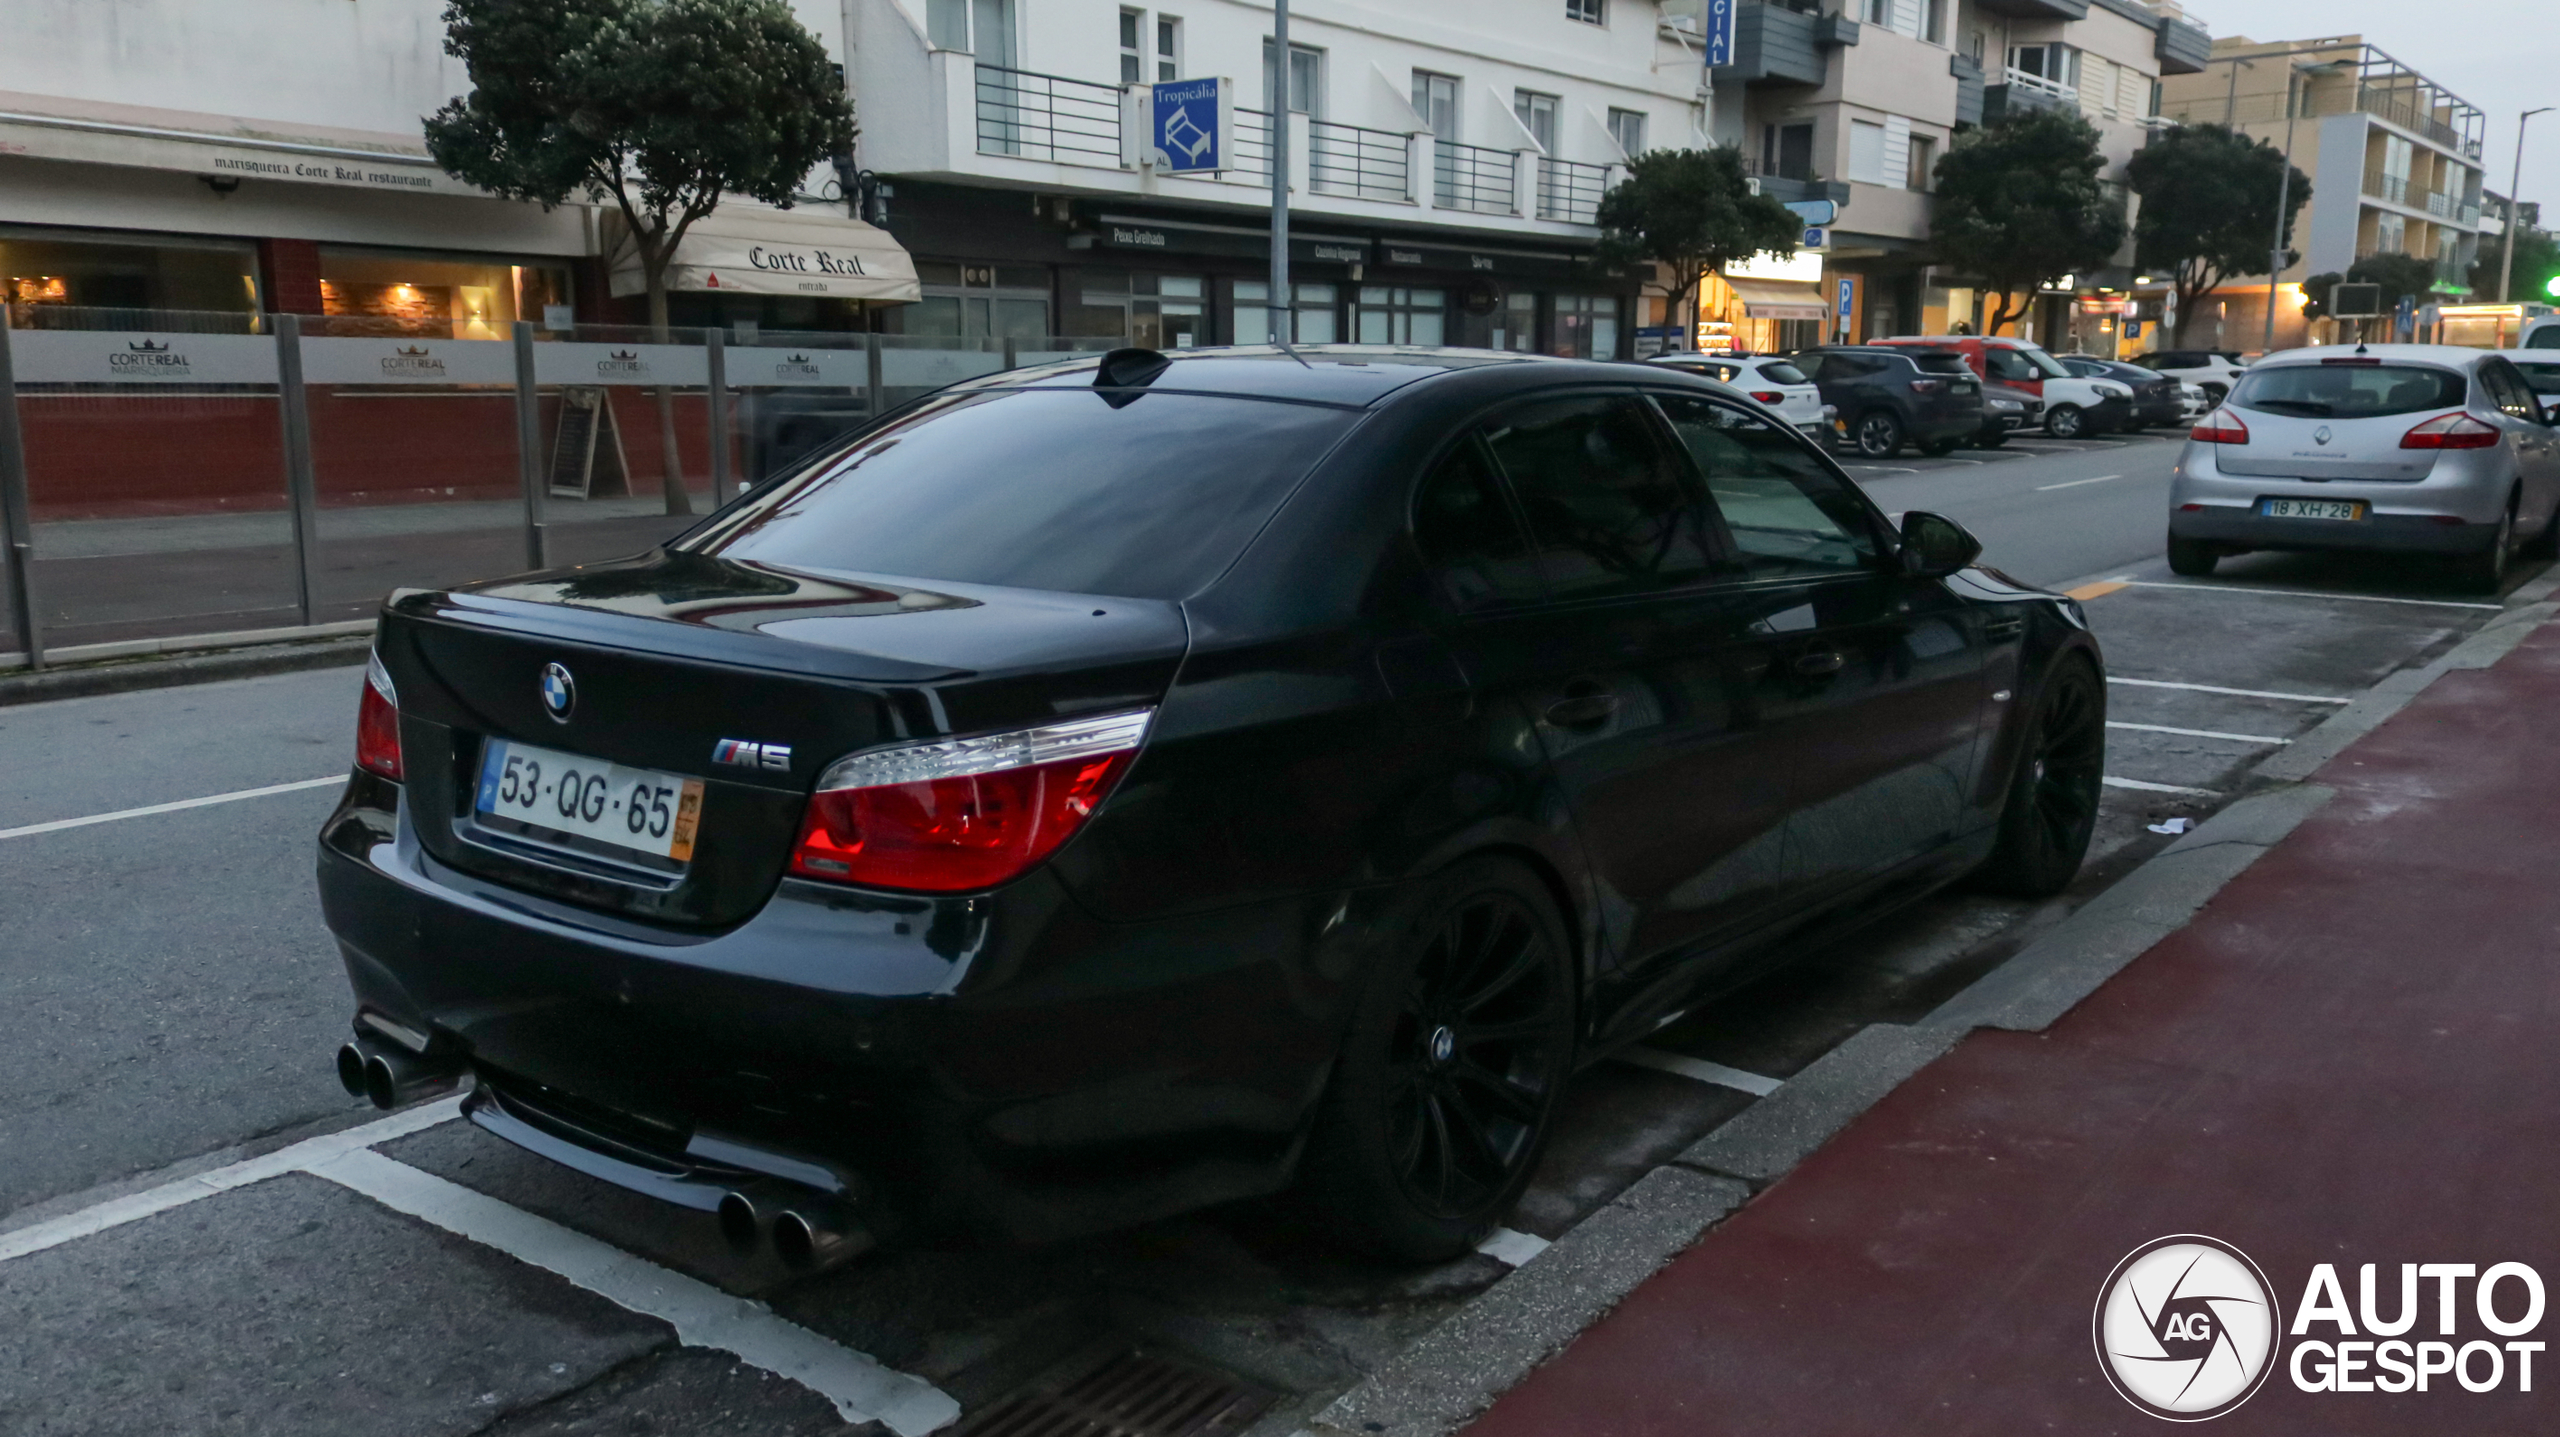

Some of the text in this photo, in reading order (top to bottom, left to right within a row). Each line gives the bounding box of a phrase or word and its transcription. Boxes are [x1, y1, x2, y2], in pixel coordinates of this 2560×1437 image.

[1155, 83, 1216, 106] Tropicália
[1156, 156, 1168, 166] AL
[215, 158, 432, 187] marisqueira Corte Real restaurante
[1114, 227, 1165, 246] Peixe Grelhado
[749, 246, 866, 276] Corte Real
[798, 282, 828, 292] entrada
[1841, 282, 1850, 312] P
[2127, 323, 2138, 337] P
[109, 353, 190, 366] CORTEREAL
[381, 357, 446, 369] CORTEREAL
[111, 365, 191, 377] MARISQUEIRA
[719, 739, 791, 771] M5
[484, 784, 493, 799] P
